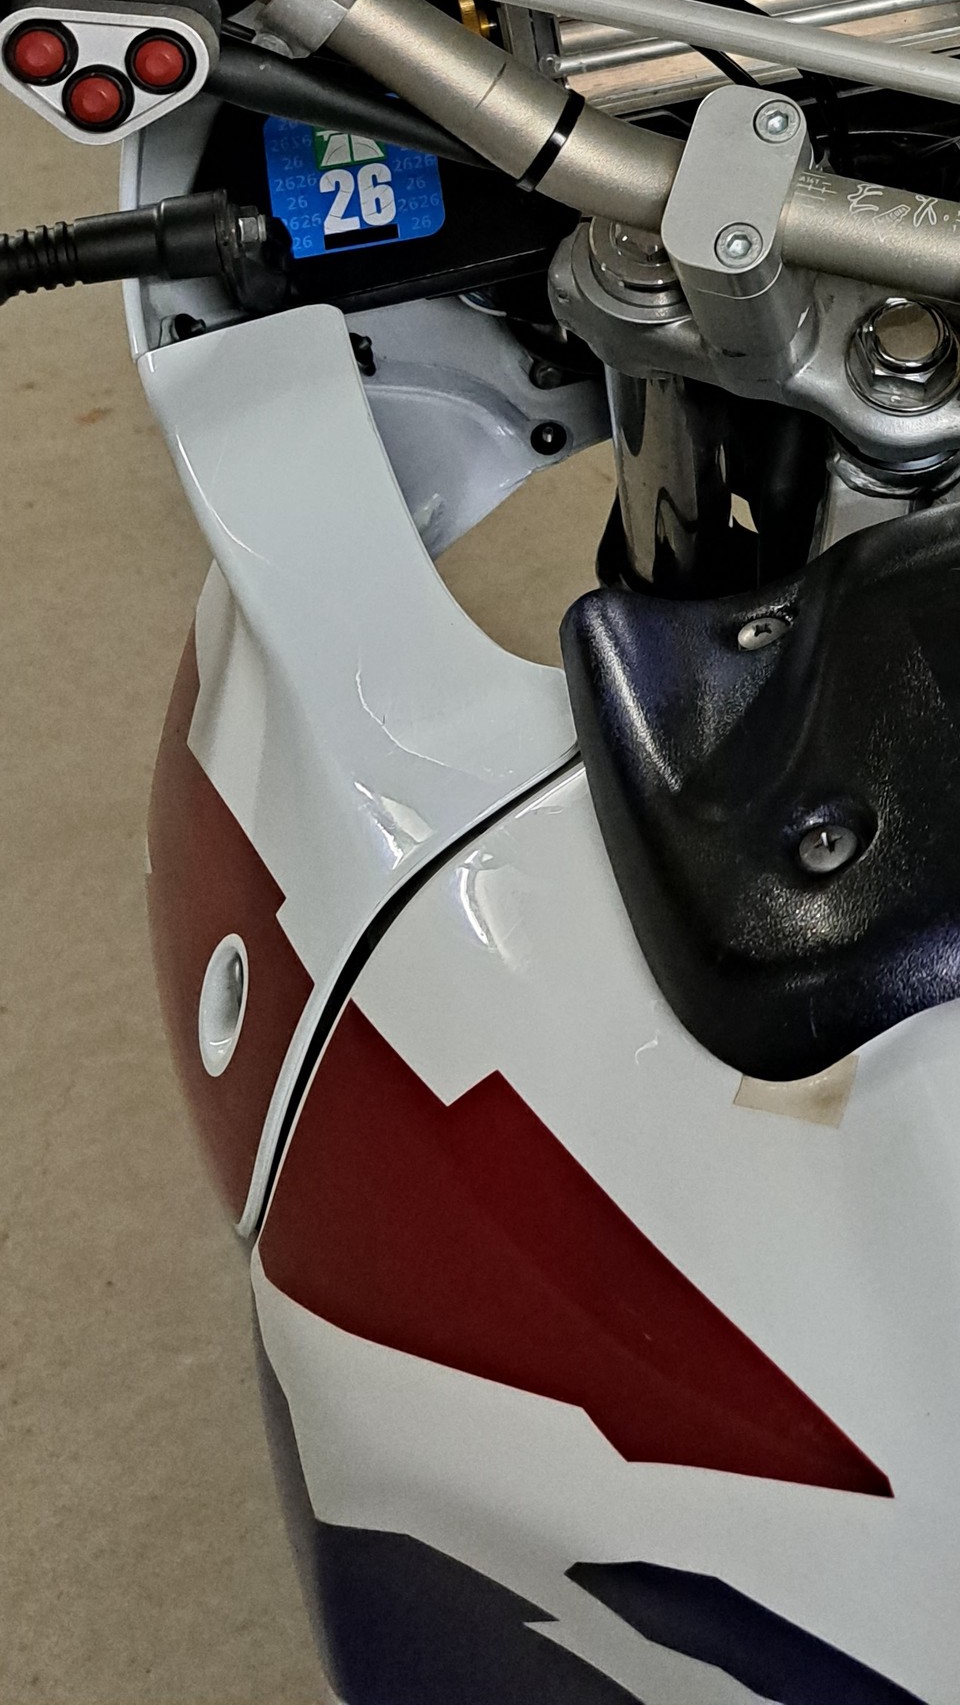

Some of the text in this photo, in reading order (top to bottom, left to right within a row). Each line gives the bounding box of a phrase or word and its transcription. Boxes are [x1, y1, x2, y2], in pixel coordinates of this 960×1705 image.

[275, 173, 318, 193] 2626
[287, 195, 308, 210] 26
[319, 162, 397, 235] 26
[398, 192, 440, 212] 2626
[411, 215, 432, 230] 26
